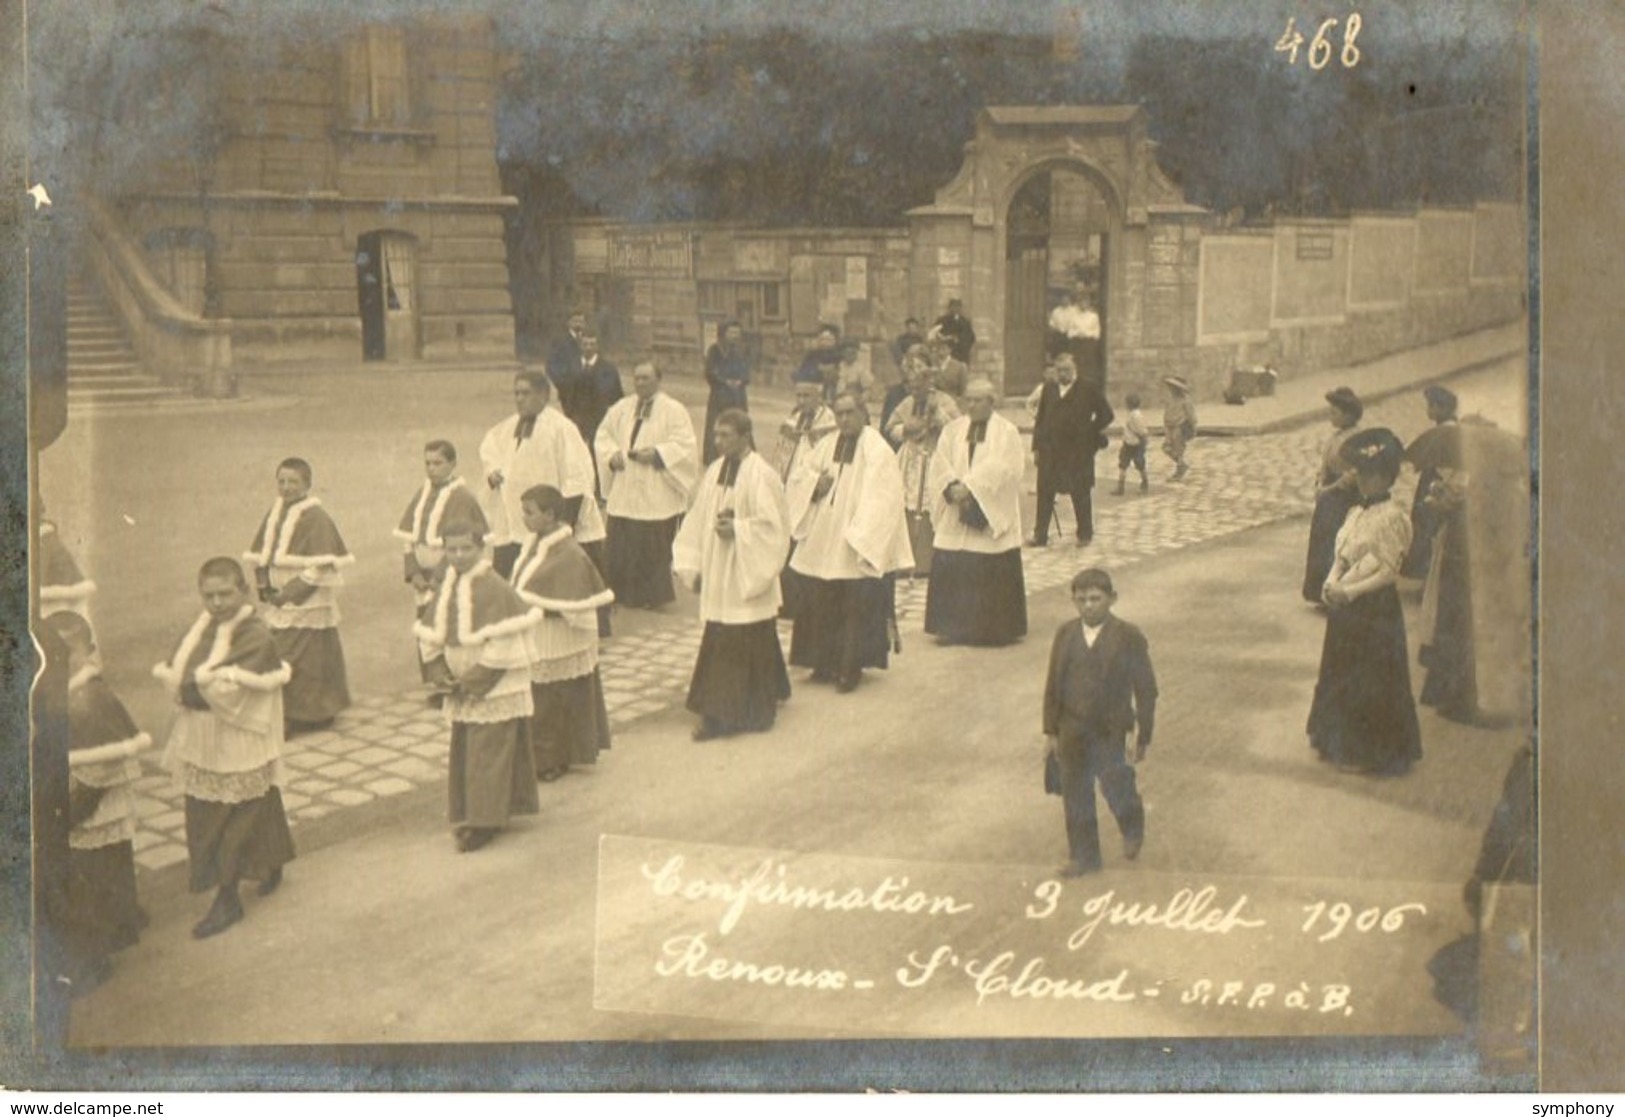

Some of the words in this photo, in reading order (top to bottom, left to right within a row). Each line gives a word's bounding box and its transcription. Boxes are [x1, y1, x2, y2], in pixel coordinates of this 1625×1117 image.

[1274, 12, 1362, 70] 468
[641, 854, 973, 935] Confirmation
[1026, 880, 1062, 919] 3
[1301, 901, 1427, 942] 1906
[1284, 981, 1311, 1009] à
